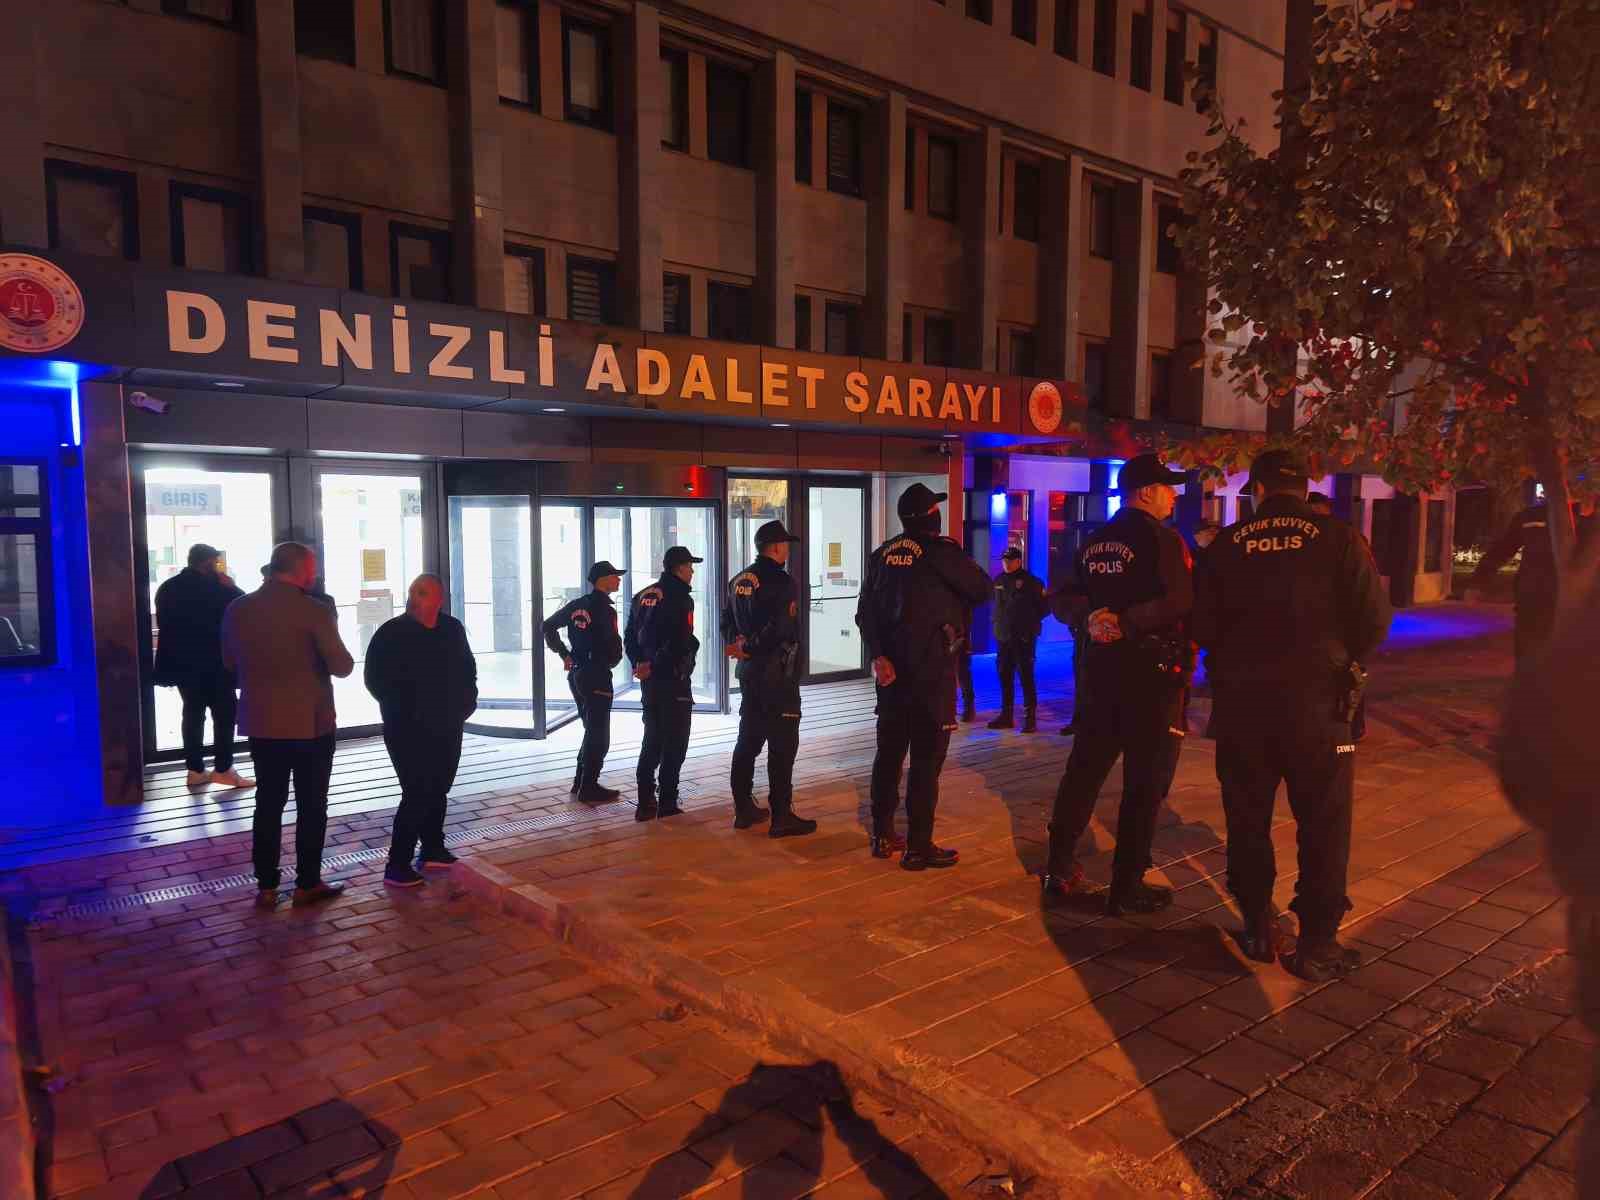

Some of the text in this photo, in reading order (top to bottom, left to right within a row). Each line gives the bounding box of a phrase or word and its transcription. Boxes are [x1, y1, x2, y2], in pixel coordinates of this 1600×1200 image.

[166, 290, 554, 387] DENİZLİ
[585, 343, 825, 409] ADALET
[844, 371, 1001, 423] SARAYI
[1272, 516, 1320, 539] KUVVET
